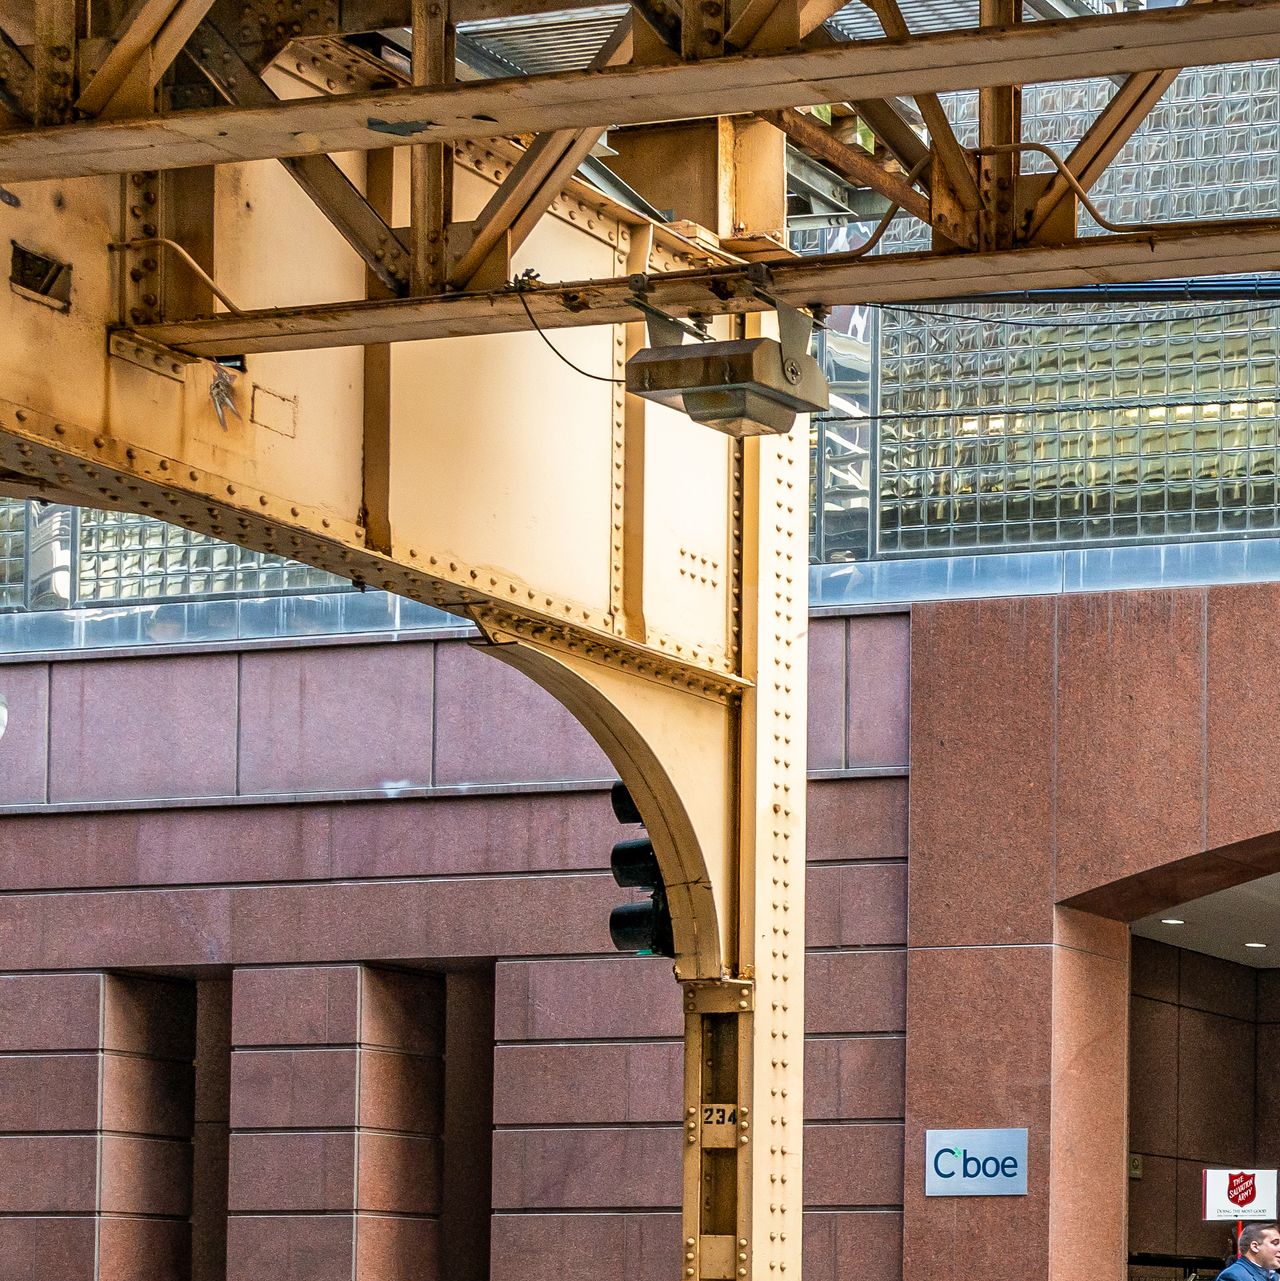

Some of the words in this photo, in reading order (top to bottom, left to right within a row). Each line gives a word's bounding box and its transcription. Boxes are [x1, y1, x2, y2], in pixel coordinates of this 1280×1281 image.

[704, 1108, 737, 1125] 234
[934, 1147, 1018, 1178] Cboe
[1229, 1177, 1254, 1199] SALVATION
[1233, 1175, 1244, 1187] THE
[1237, 1187, 1252, 1203] ARMY
